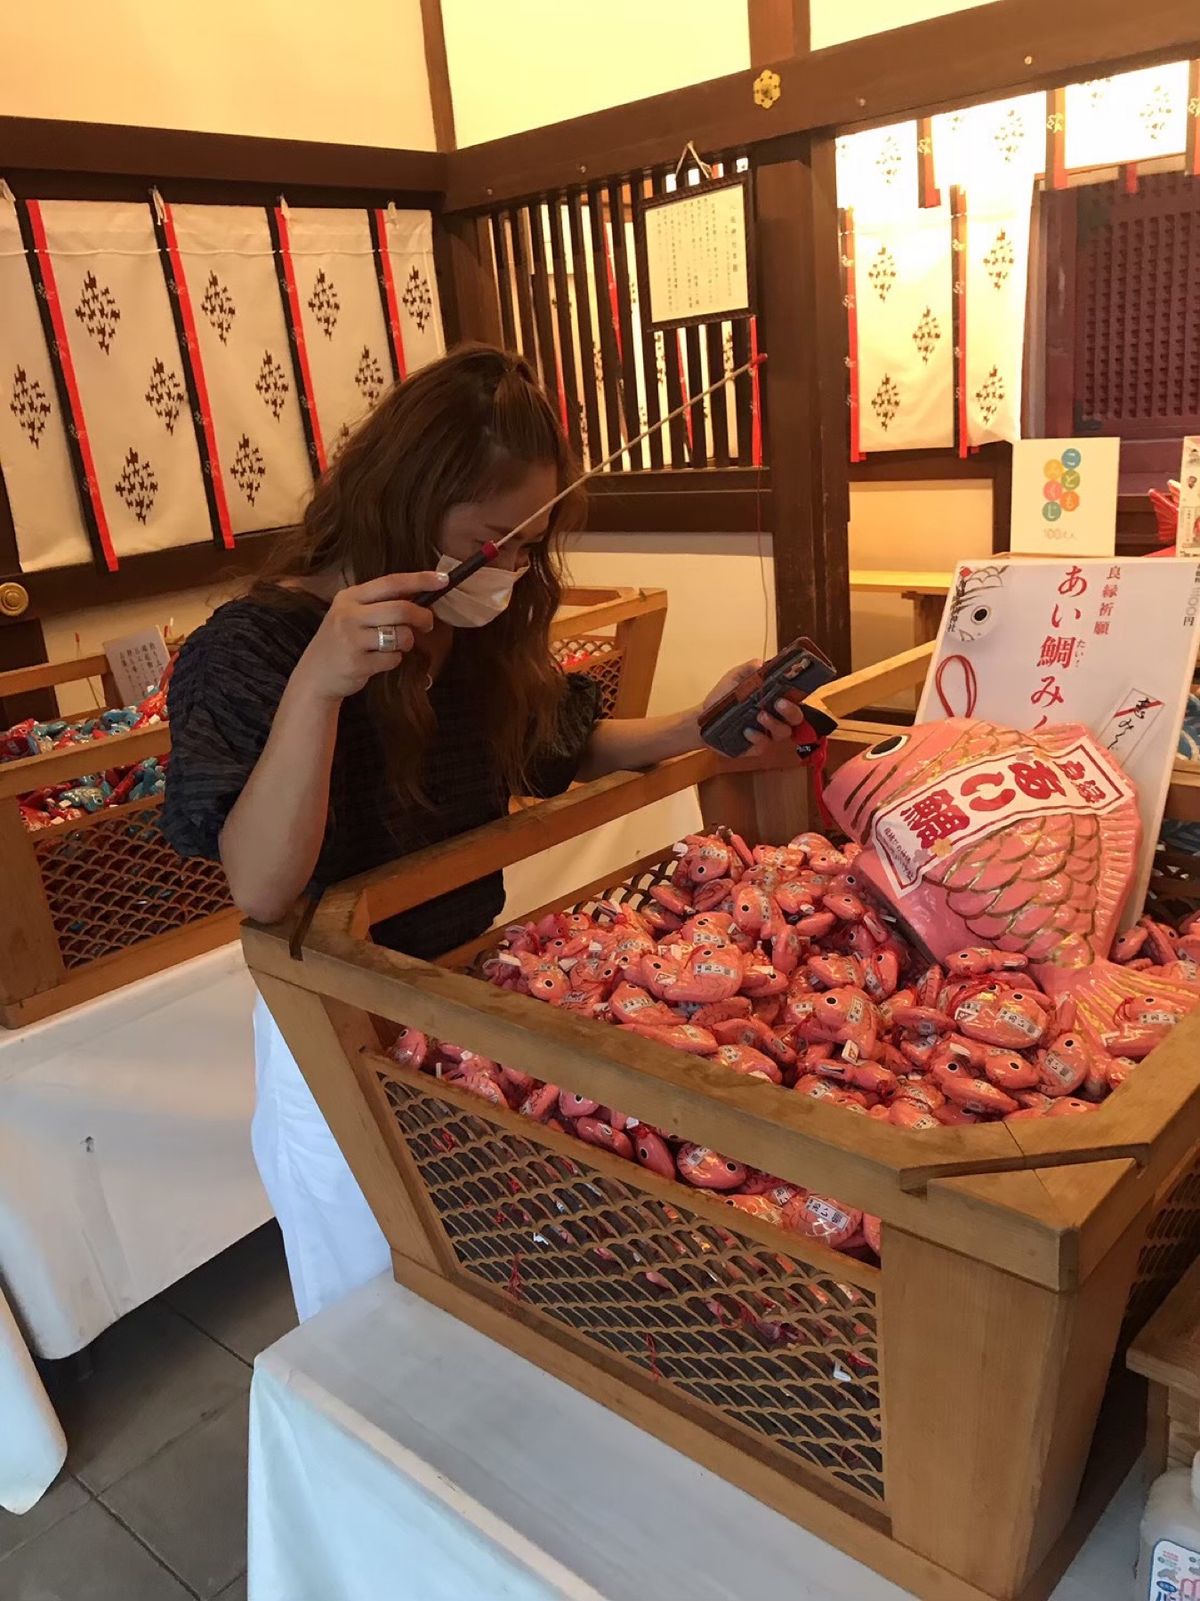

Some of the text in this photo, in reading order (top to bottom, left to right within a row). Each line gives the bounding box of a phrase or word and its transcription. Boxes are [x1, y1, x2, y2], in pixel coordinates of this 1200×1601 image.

[1093, 565, 1121, 635] 良縁祈願
[900, 760, 1067, 849] あい鯛
